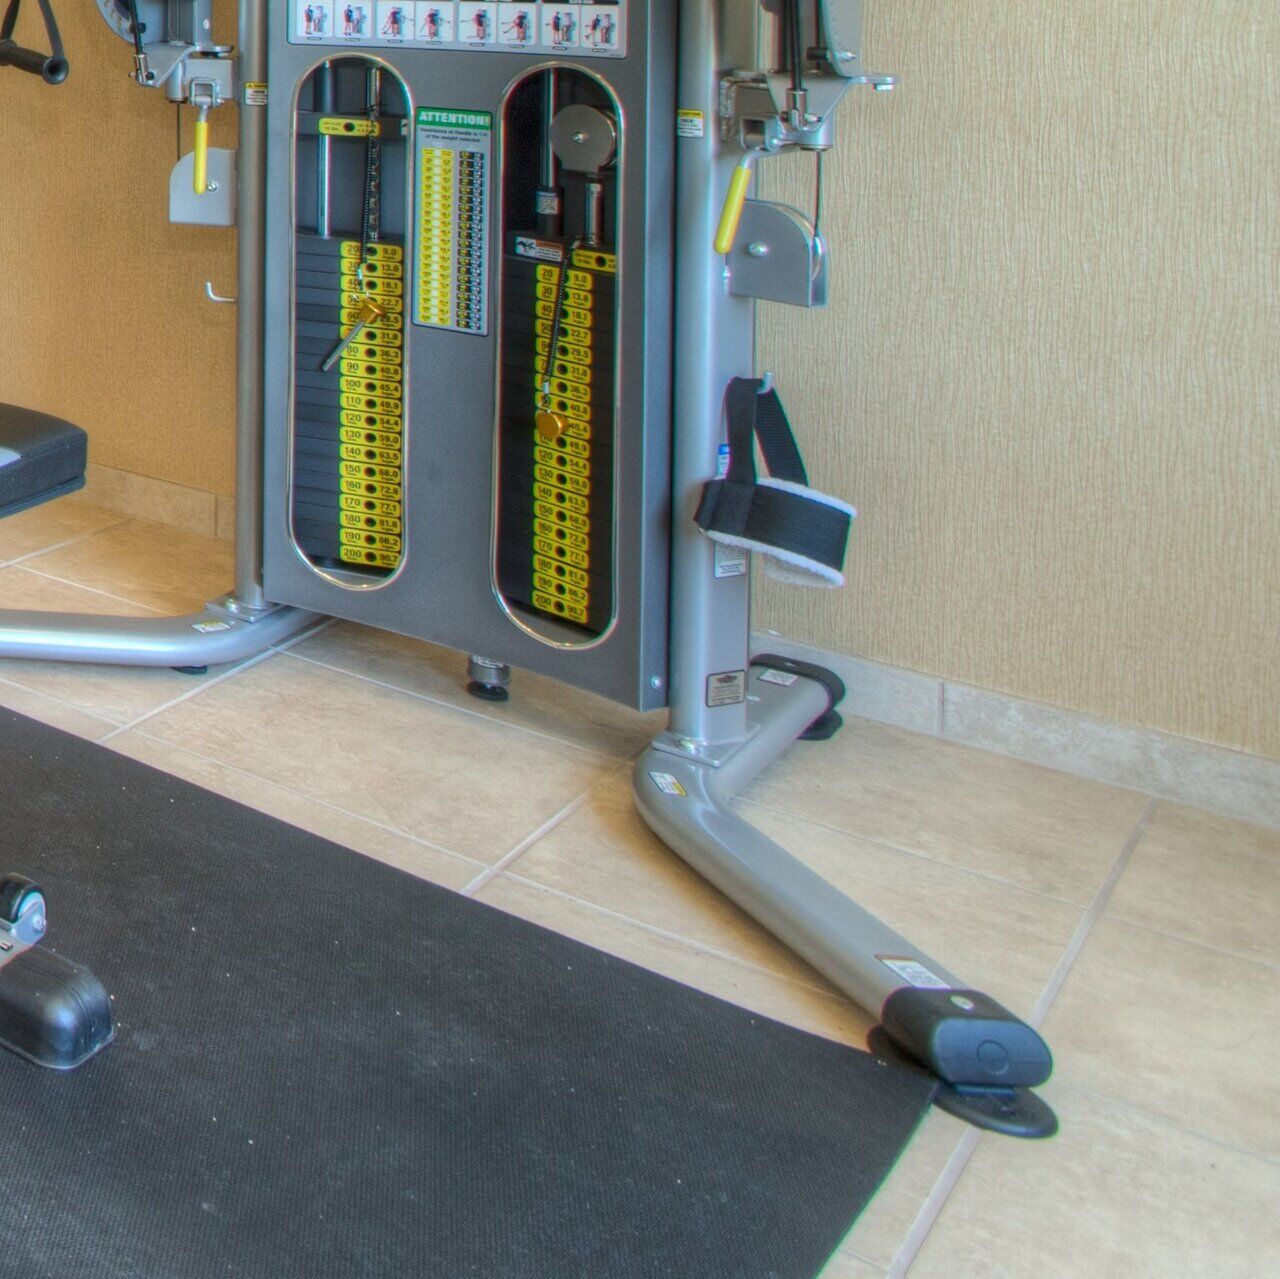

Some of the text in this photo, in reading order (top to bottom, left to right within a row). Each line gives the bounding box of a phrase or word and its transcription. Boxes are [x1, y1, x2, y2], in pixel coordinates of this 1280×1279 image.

[420, 111, 490, 126] ATTENTION!
[347, 362, 359, 370] 90
[345, 379, 361, 388] 100
[345, 396, 361, 404] 110
[345, 413, 361, 421] 120
[345, 429, 361, 438] 130
[345, 446, 361, 454] 140
[344, 464, 361, 472] 150
[345, 481, 361, 489] 160
[344, 497, 360, 505] 170
[345, 514, 360, 523] 180
[344, 532, 361, 540] 190
[344, 548, 362, 557] 200
